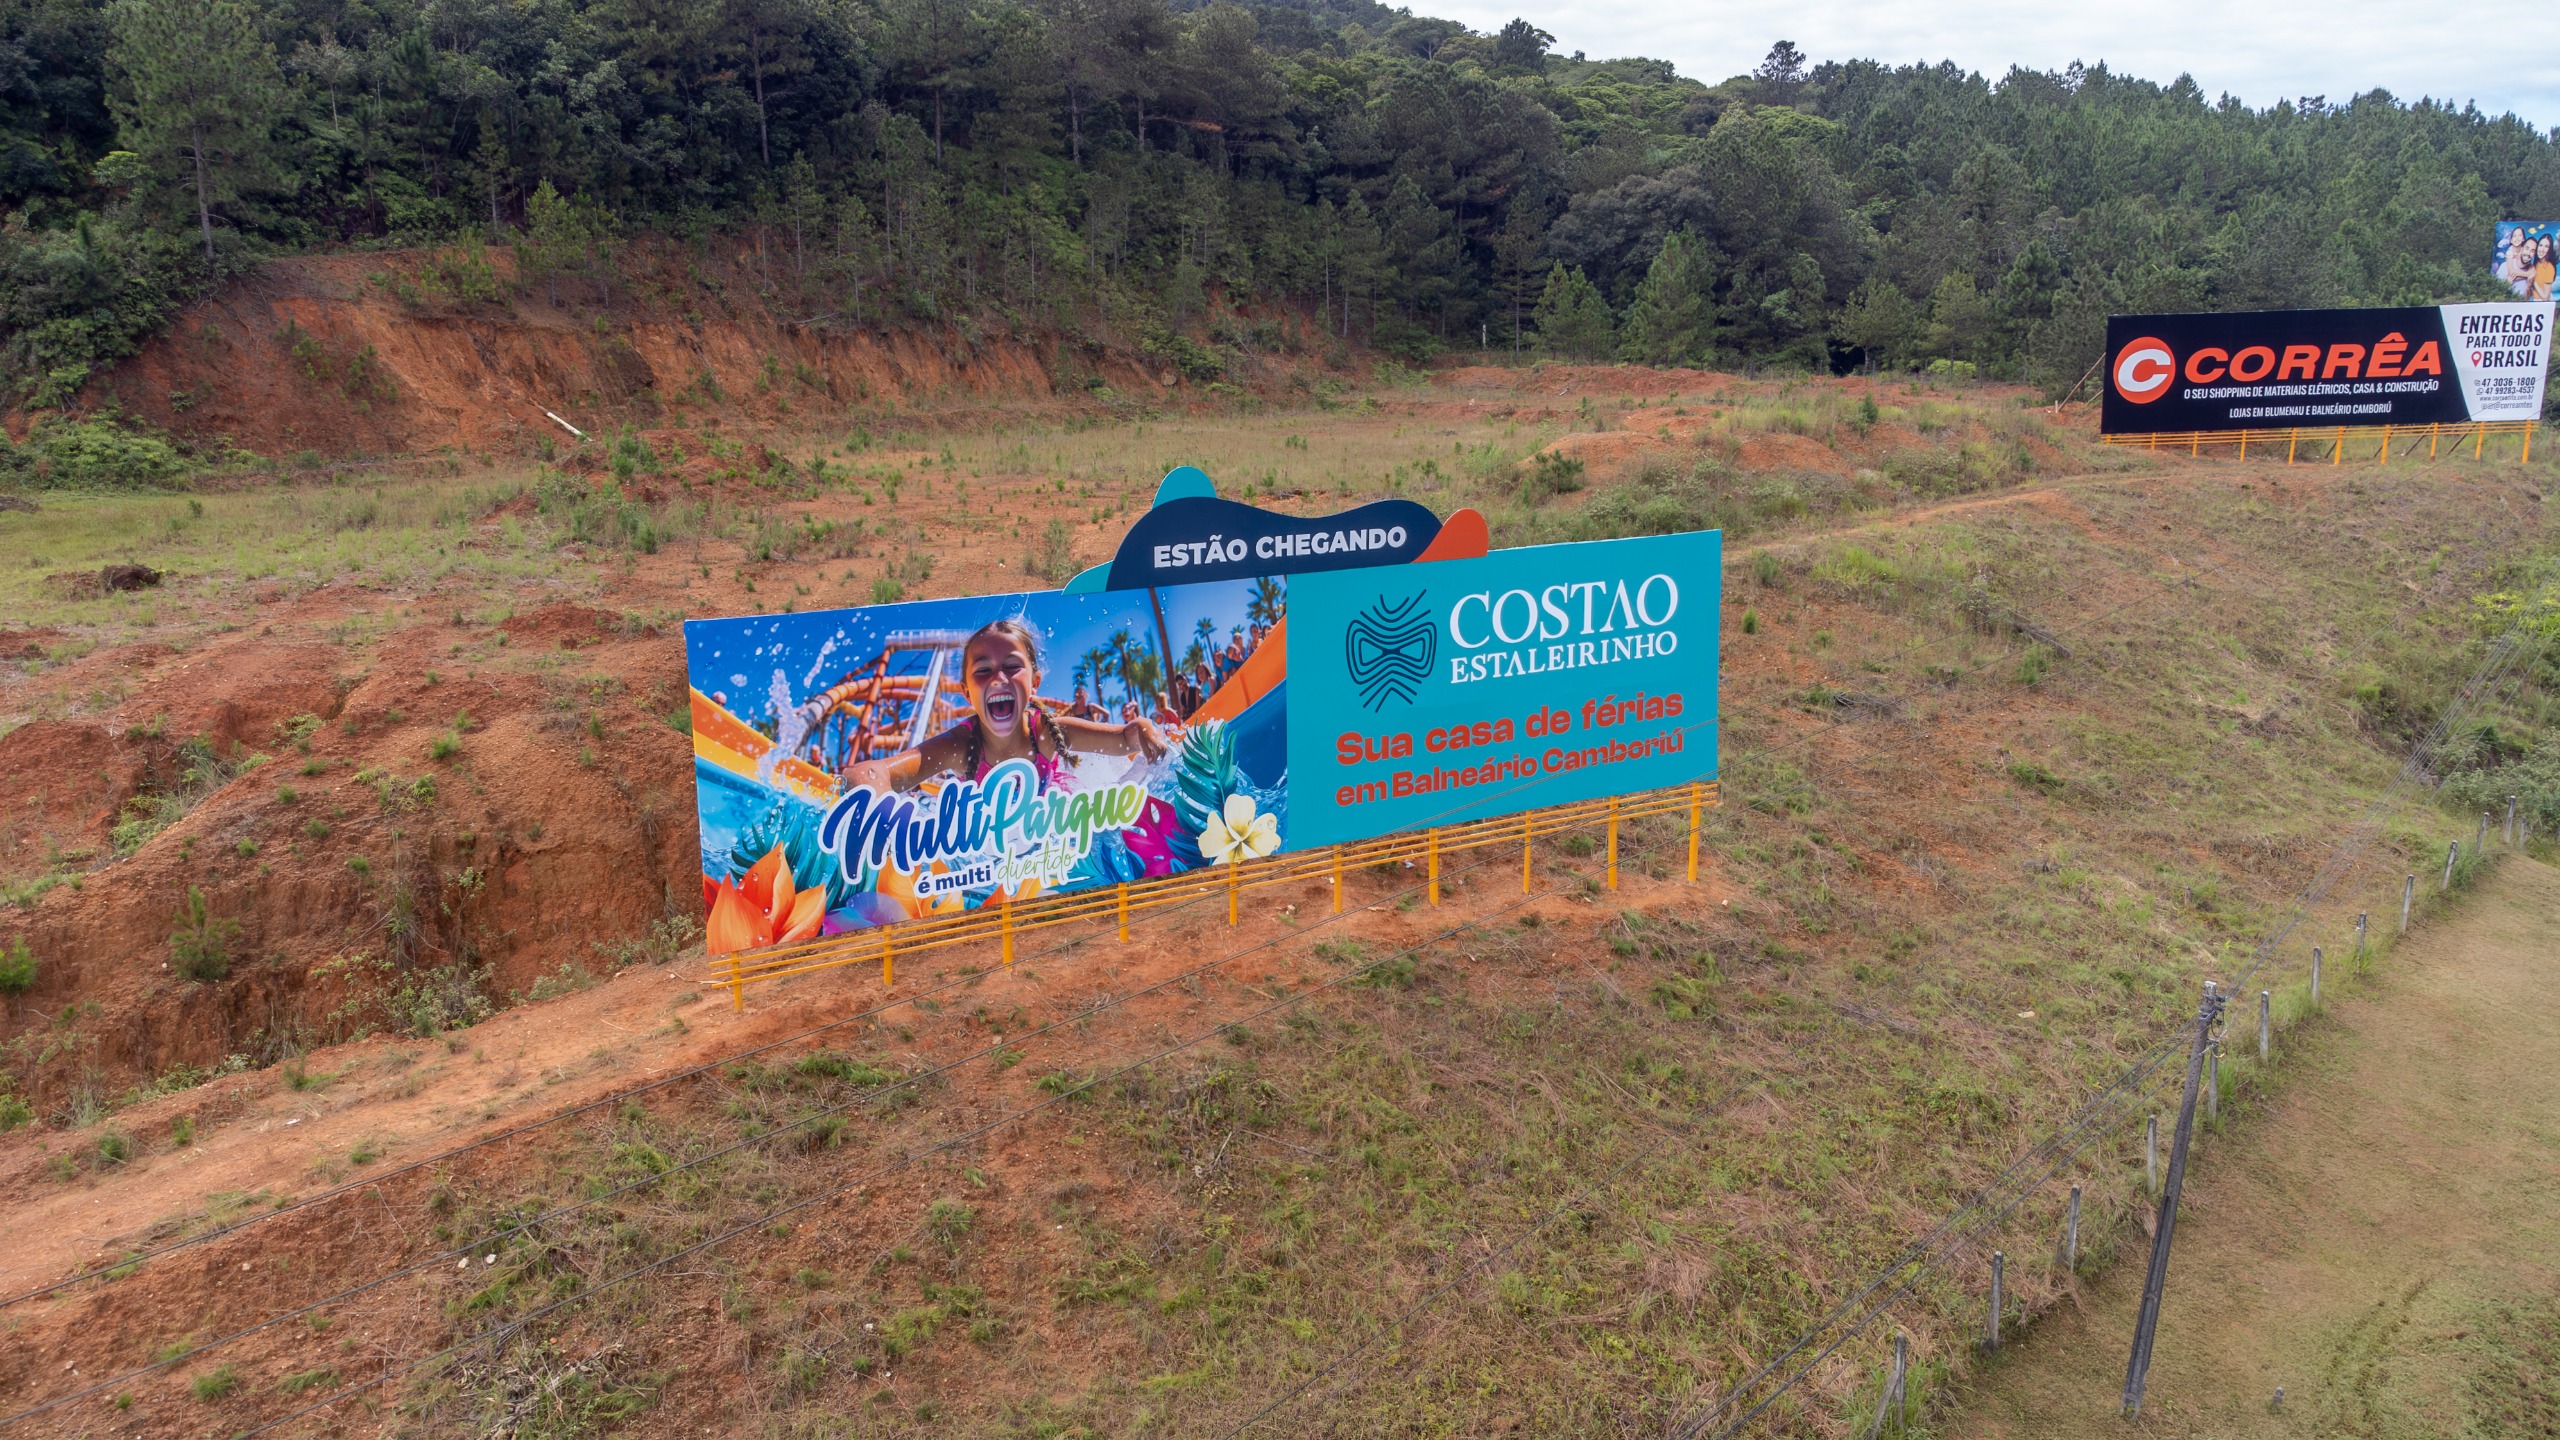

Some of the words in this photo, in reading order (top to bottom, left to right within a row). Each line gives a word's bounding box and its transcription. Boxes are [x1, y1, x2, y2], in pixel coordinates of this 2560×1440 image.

[2460, 314, 2544, 334] ENTREGAS
[2466, 335, 2496, 348] PARA
[2501, 335, 2531, 347] TODO
[2534, 334, 2542, 346] O
[2184, 332, 2442, 384] CORRÊA
[2482, 350, 2538, 368] BRASIL
[2184, 389, 2190, 399] O
[2192, 388, 2208, 399] SEU
[2209, 386, 2251, 398] SHOPPING
[2253, 387, 2263, 397] DE
[2264, 385, 2307, 396] MATERIAIS
[2308, 382, 2352, 396] ELÉTRICOS,
[2353, 383, 2374, 394] CASA
[2376, 383, 2383, 393] &
[2385, 379, 2439, 394] CONSTRUÇÃO
[2482, 378, 2491, 387] 47
[2493, 377, 2536, 387] 3036-1800
[2485, 387, 2493, 395] 47
[2495, 386, 2535, 395] 99283-4537
[2229, 407, 2251, 418] LOJAS
[2253, 407, 2263, 417] EM
[2265, 406, 2304, 417] BLUMENAU
[2306, 406, 2310, 415] E
[2312, 403, 2351, 415] BALNEÁRIO
[2353, 402, 2392, 414] CAMBORIÚ
[1153, 534, 1248, 569] ESTÃO
[1256, 525, 1408, 560] CHEGANDO
[1450, 630, 1678, 684] ESTALEIRINHO
[1336, 730, 1413, 766] Sua
[1424, 717, 1515, 754] casa
[1524, 704, 1571, 738] de
[1581, 691, 1684, 729] férias
[1336, 781, 1388, 807] em
[1392, 755, 1539, 800] Balneário
[1542, 726, 1684, 774] Camboriú
[918, 876, 931, 894] é
[935, 865, 993, 891] multi
[996, 839, 1077, 891] divertido
